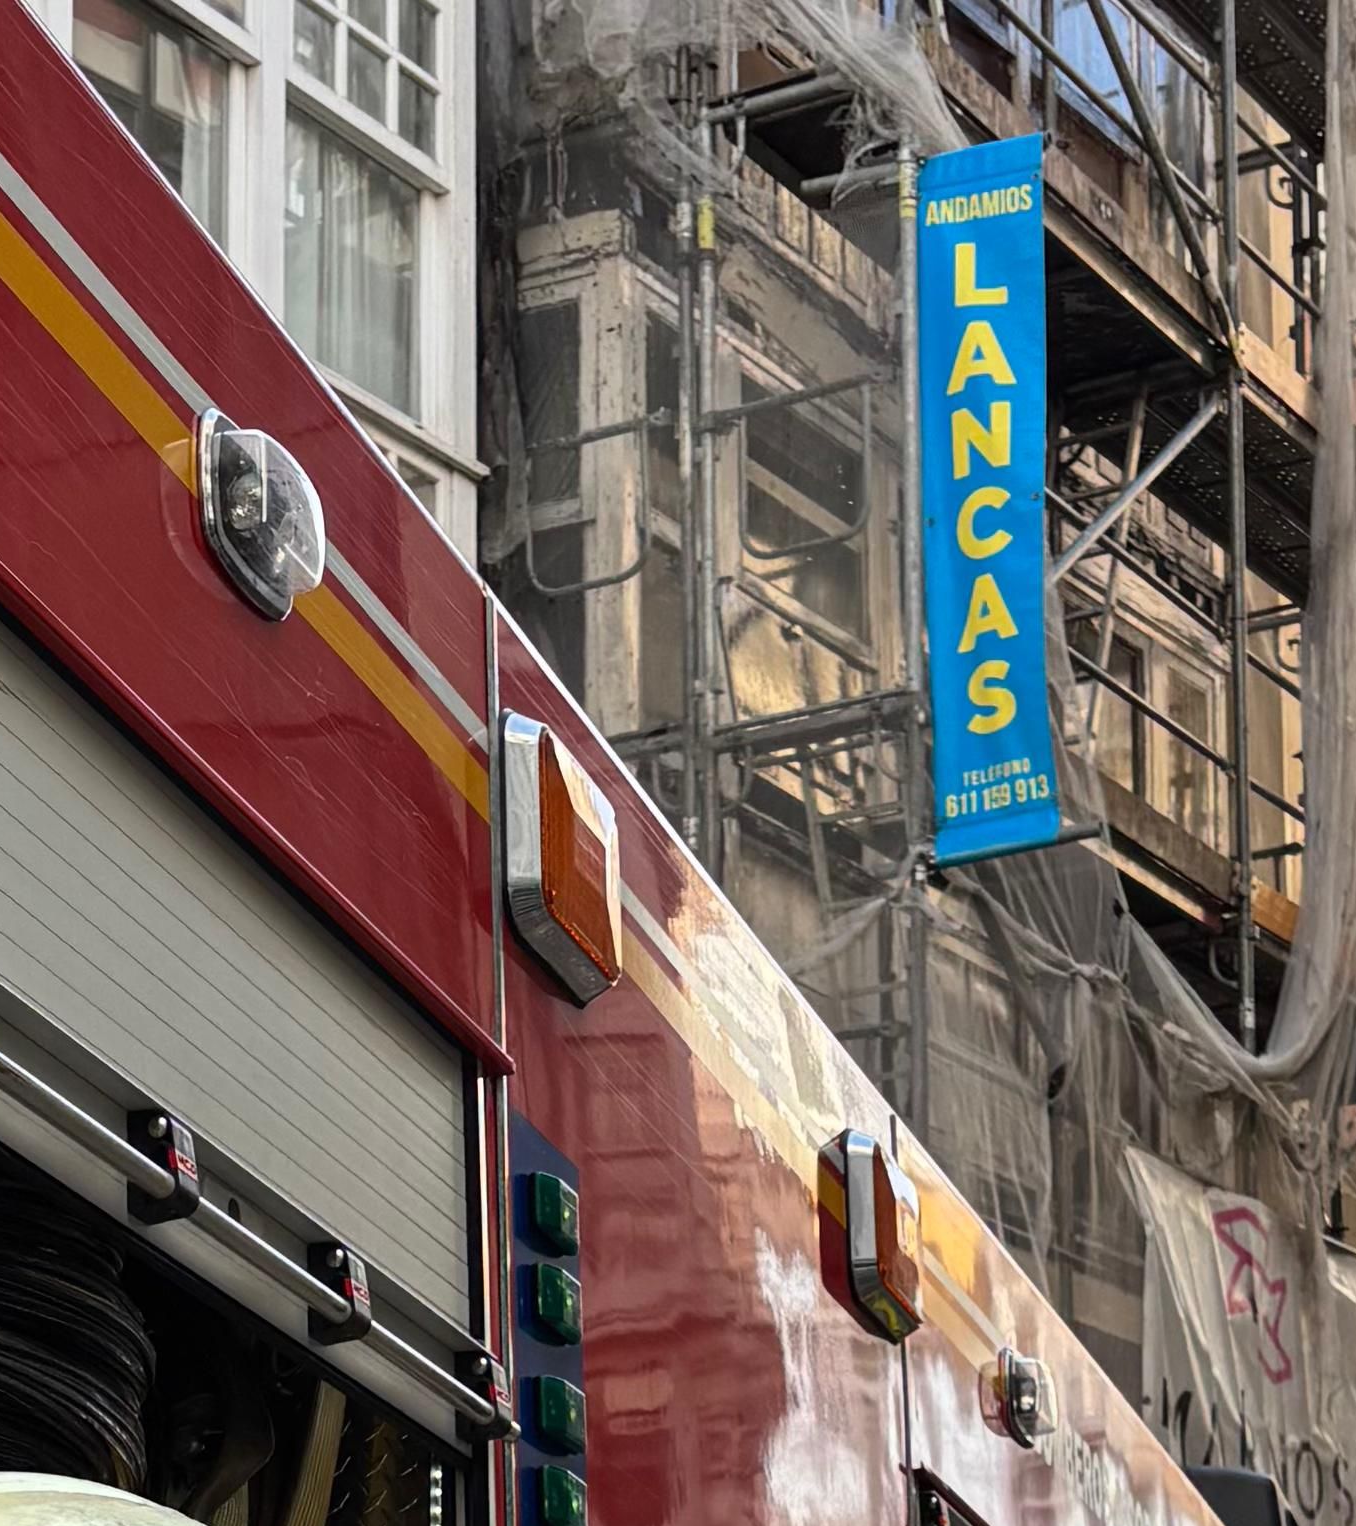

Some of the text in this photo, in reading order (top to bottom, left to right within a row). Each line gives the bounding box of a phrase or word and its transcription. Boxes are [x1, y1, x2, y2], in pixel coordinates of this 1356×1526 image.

[925, 184, 1033, 226] ANDAMIOS
[946, 243, 1017, 734] LANCAS
[946, 774, 1049, 818] 611 159 913
